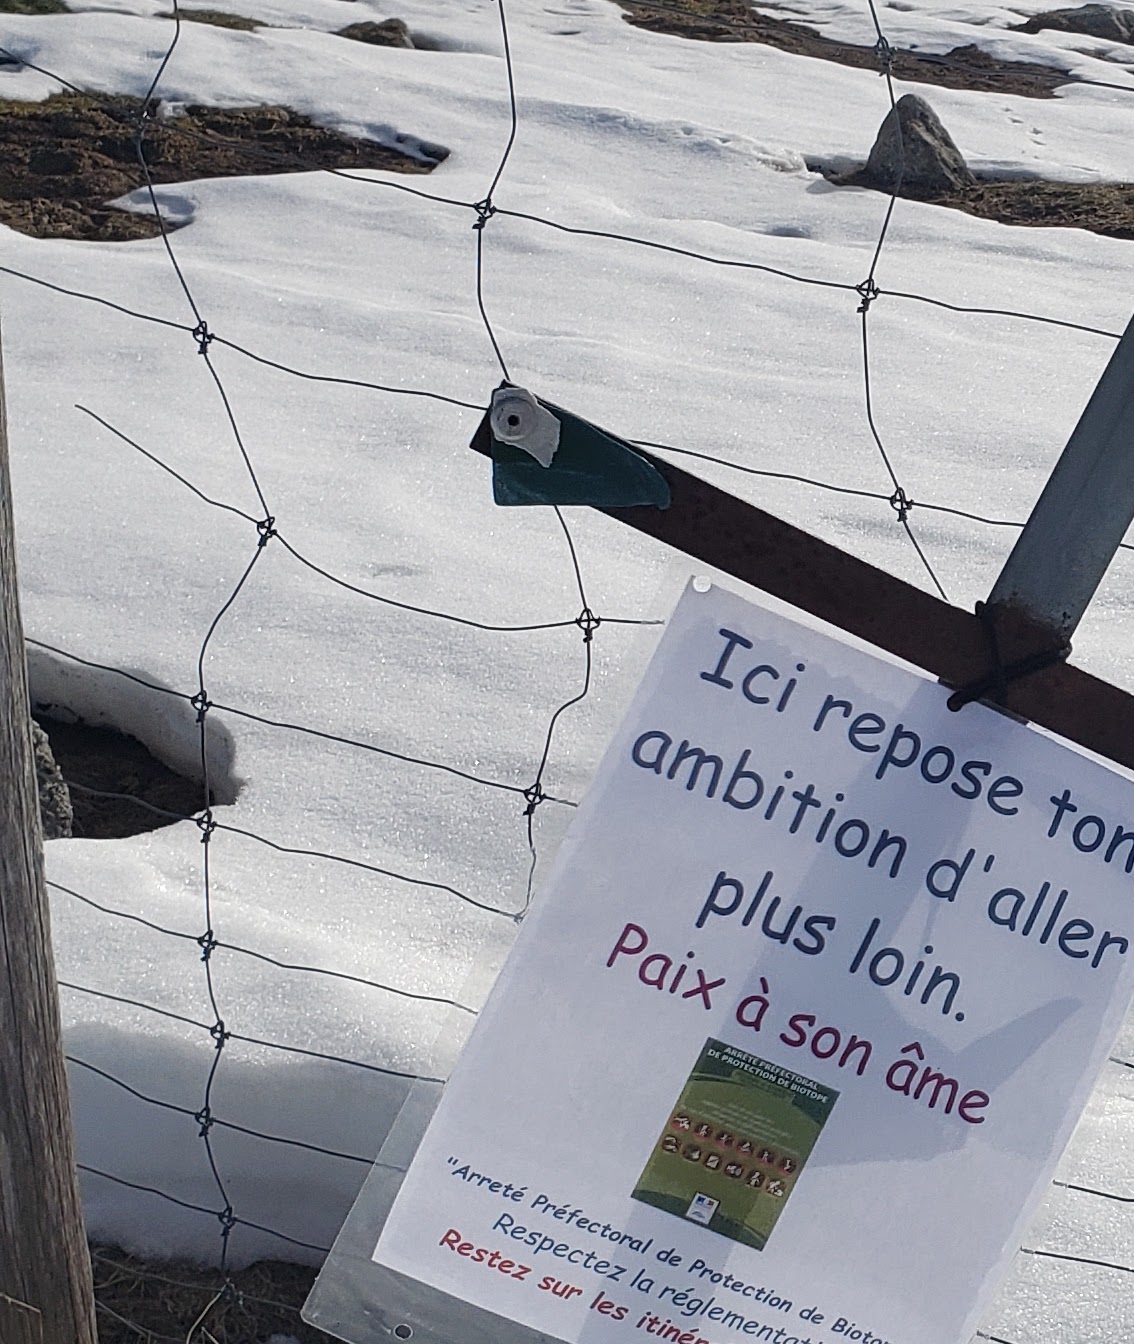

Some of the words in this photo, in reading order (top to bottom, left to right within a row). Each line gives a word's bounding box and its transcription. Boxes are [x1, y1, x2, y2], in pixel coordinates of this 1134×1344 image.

[700, 628, 806, 713] Ici
[812, 694, 1024, 816] repose
[631, 729, 907, 878] ambition
[926, 848, 1129, 968] d'aller
[606, 923, 726, 1010] Paix
[735, 977, 770, 1032] à
[779, 1012, 873, 1076] son
[886, 1042, 990, 1124] âme
[695, 870, 837, 956] plus
[849, 917, 965, 1022] loin.
[708, 1048, 721, 1059] DE
[721, 1055, 777, 1083] PROTECTION
[777, 1077, 790, 1088] DE
[790, 1083, 829, 1104] BIOTOPE
[439, 1229, 532, 1281] Restez
[537, 1276, 583, 1300] sur
[590, 1291, 629, 1321] les
[447, 1157, 528, 1202] "Arreté
[531, 1194, 653, 1254] Préfectoral
[657, 1248, 682, 1267] de
[688, 1259, 793, 1312] Protection
[799, 1307, 824, 1324] de
[492, 1213, 627, 1282] Respectez
[630, 1268, 654, 1294] la
